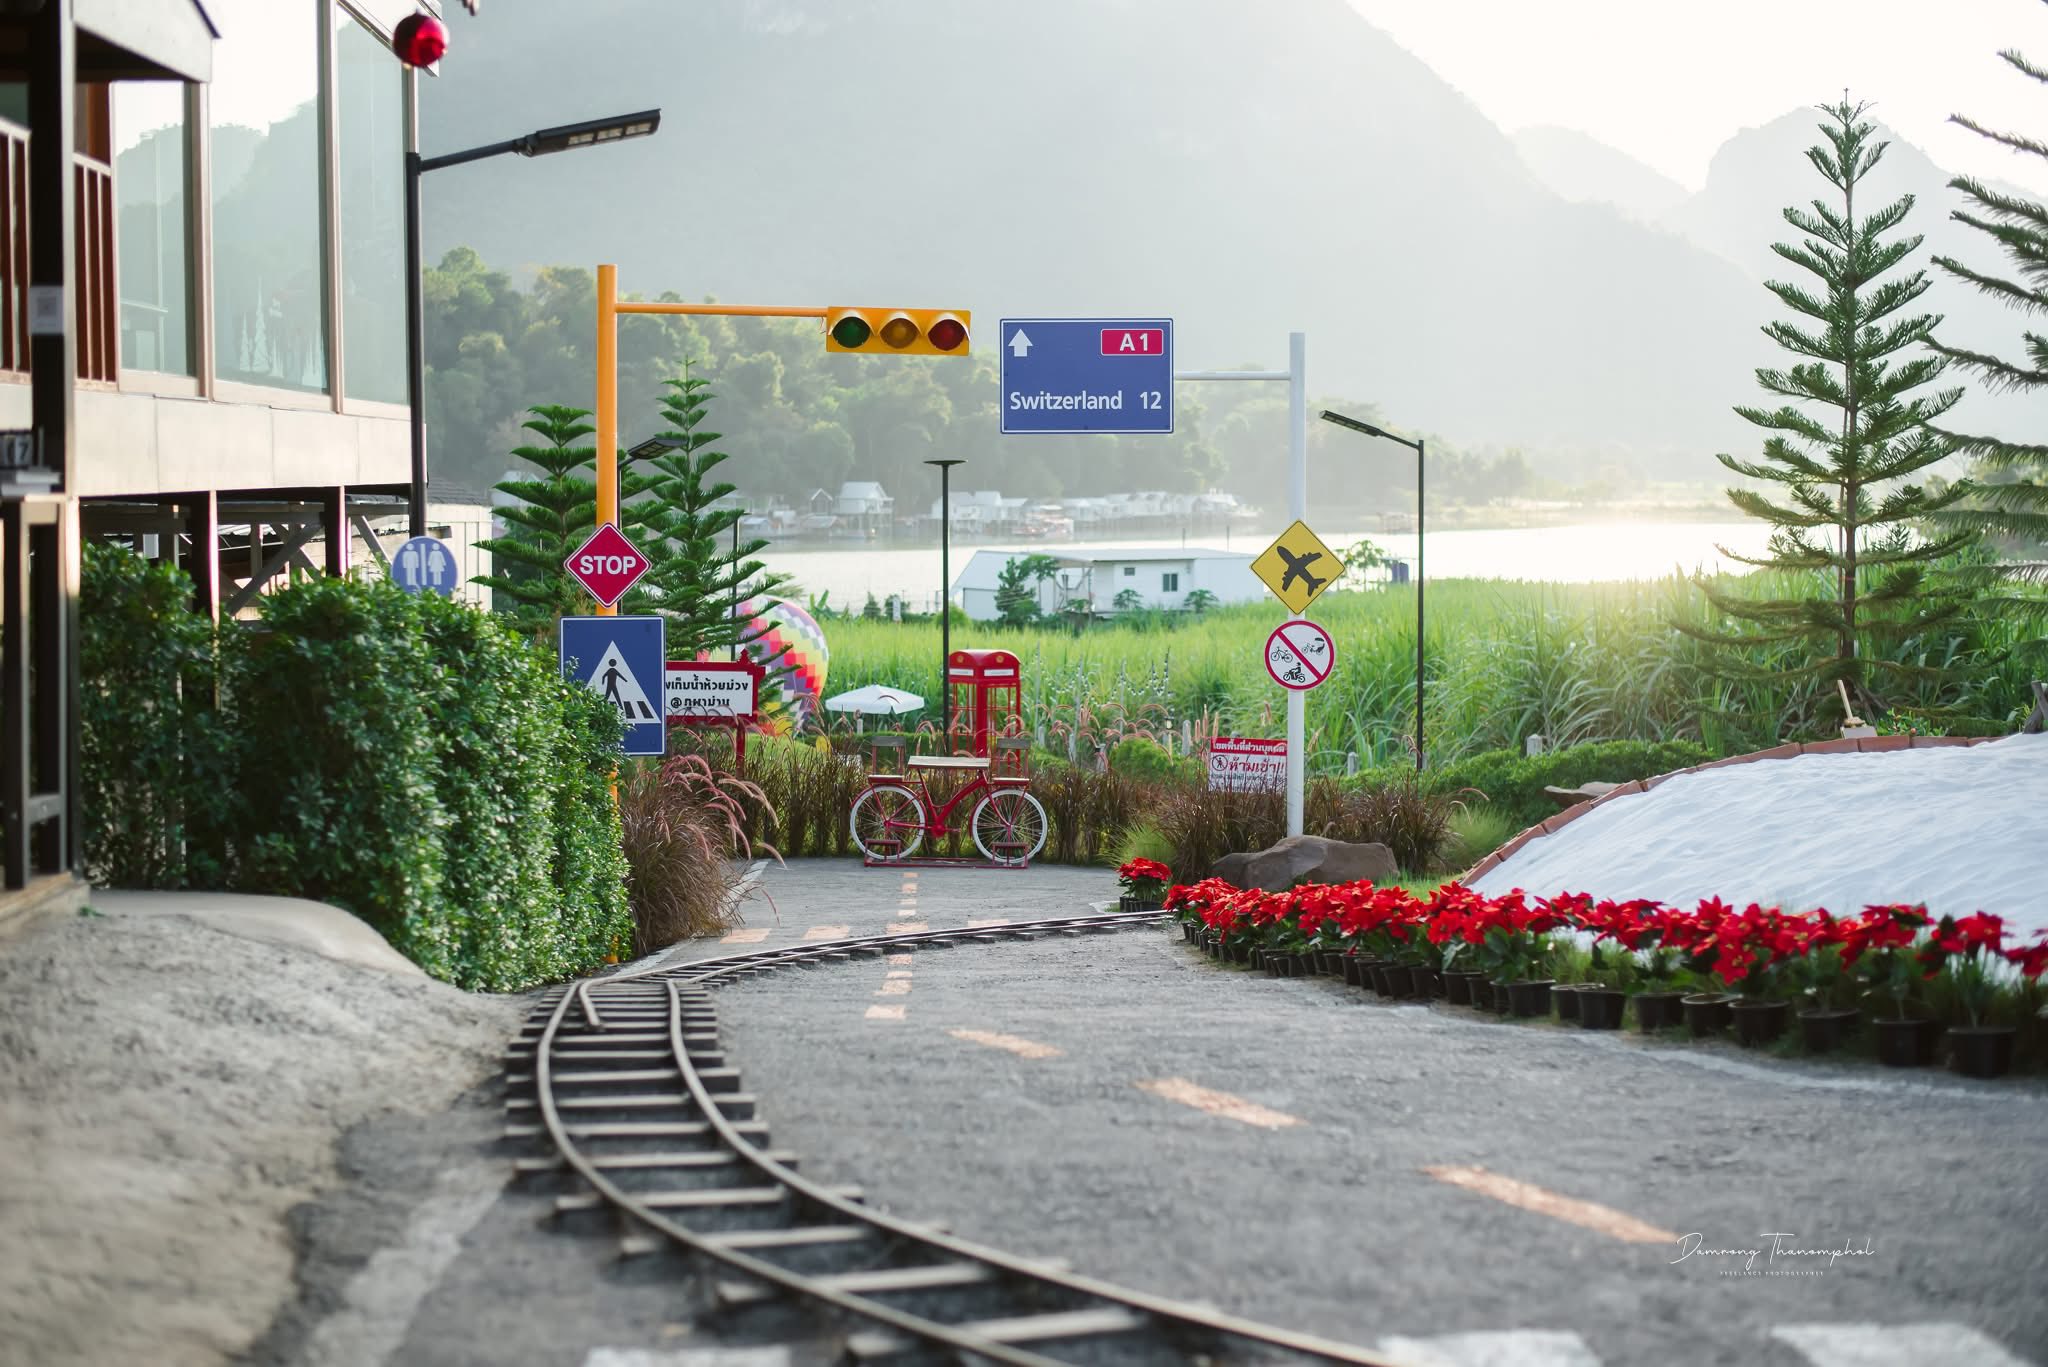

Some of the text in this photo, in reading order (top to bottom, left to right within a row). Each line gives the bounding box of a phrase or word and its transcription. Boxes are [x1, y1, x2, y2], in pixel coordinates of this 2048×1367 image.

[1119, 332, 1149, 352] A1
[1010, 390, 1162, 410] Switzerland 12
[579, 555, 637, 575] STOP
